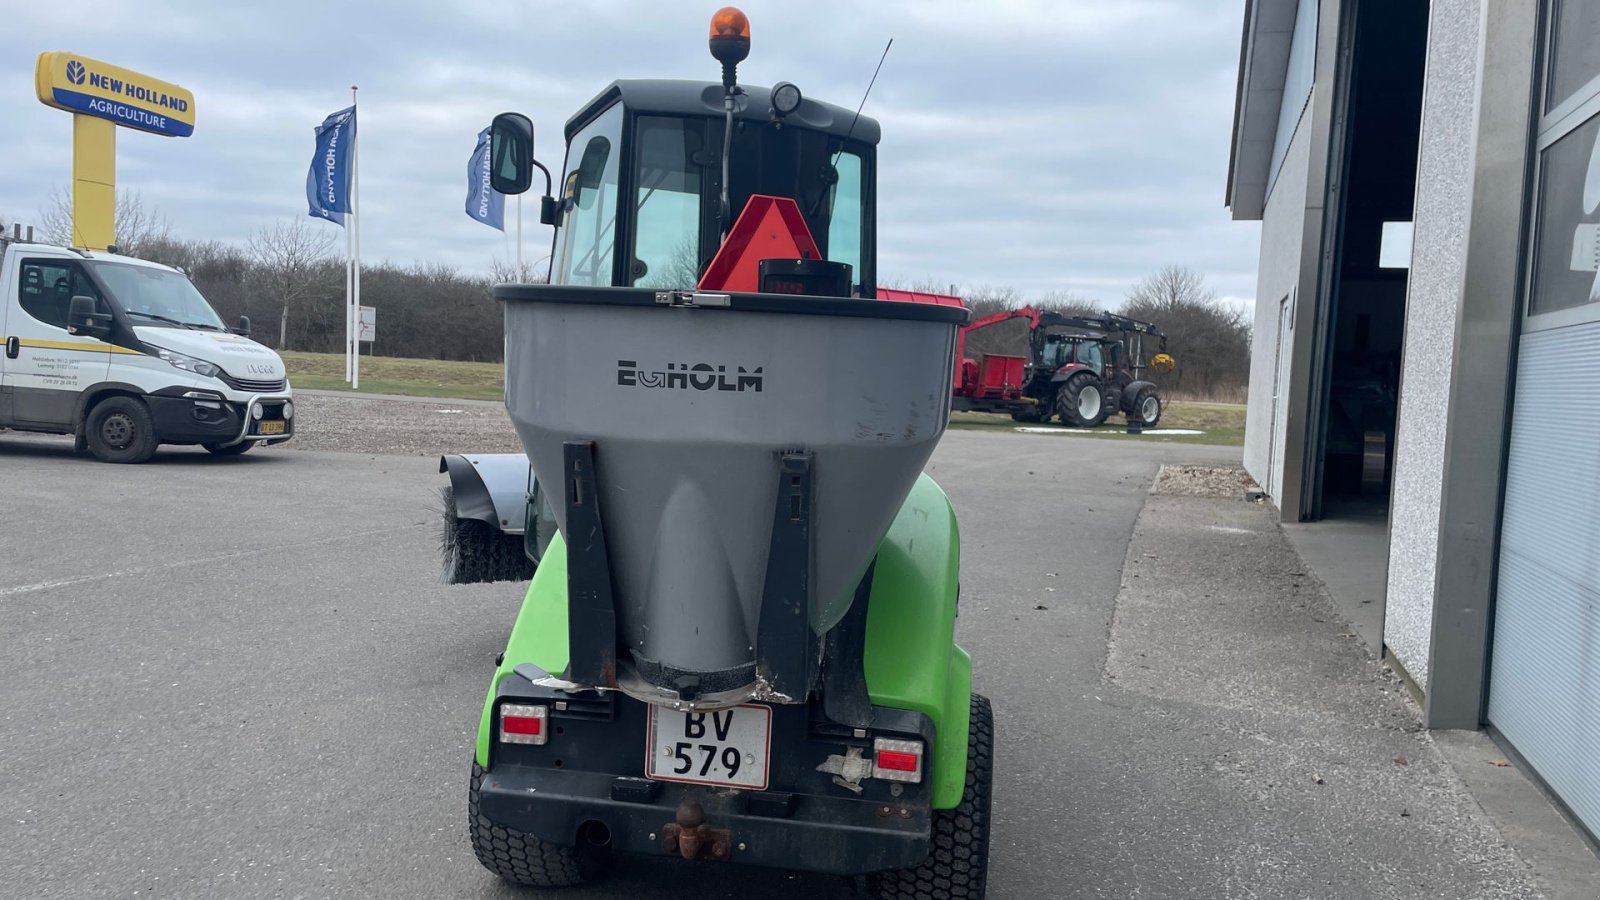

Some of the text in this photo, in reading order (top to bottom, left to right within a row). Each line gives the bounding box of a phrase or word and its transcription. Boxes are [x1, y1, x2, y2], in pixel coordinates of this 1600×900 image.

[89, 72, 187, 112] NEW HOLLAND
[88, 98, 166, 128] AGRICULTURE
[326, 149, 336, 203] HOLLAND
[480, 170, 491, 218] HOLLAND
[684, 709, 734, 741] BV
[673, 742, 741, 779] 579
